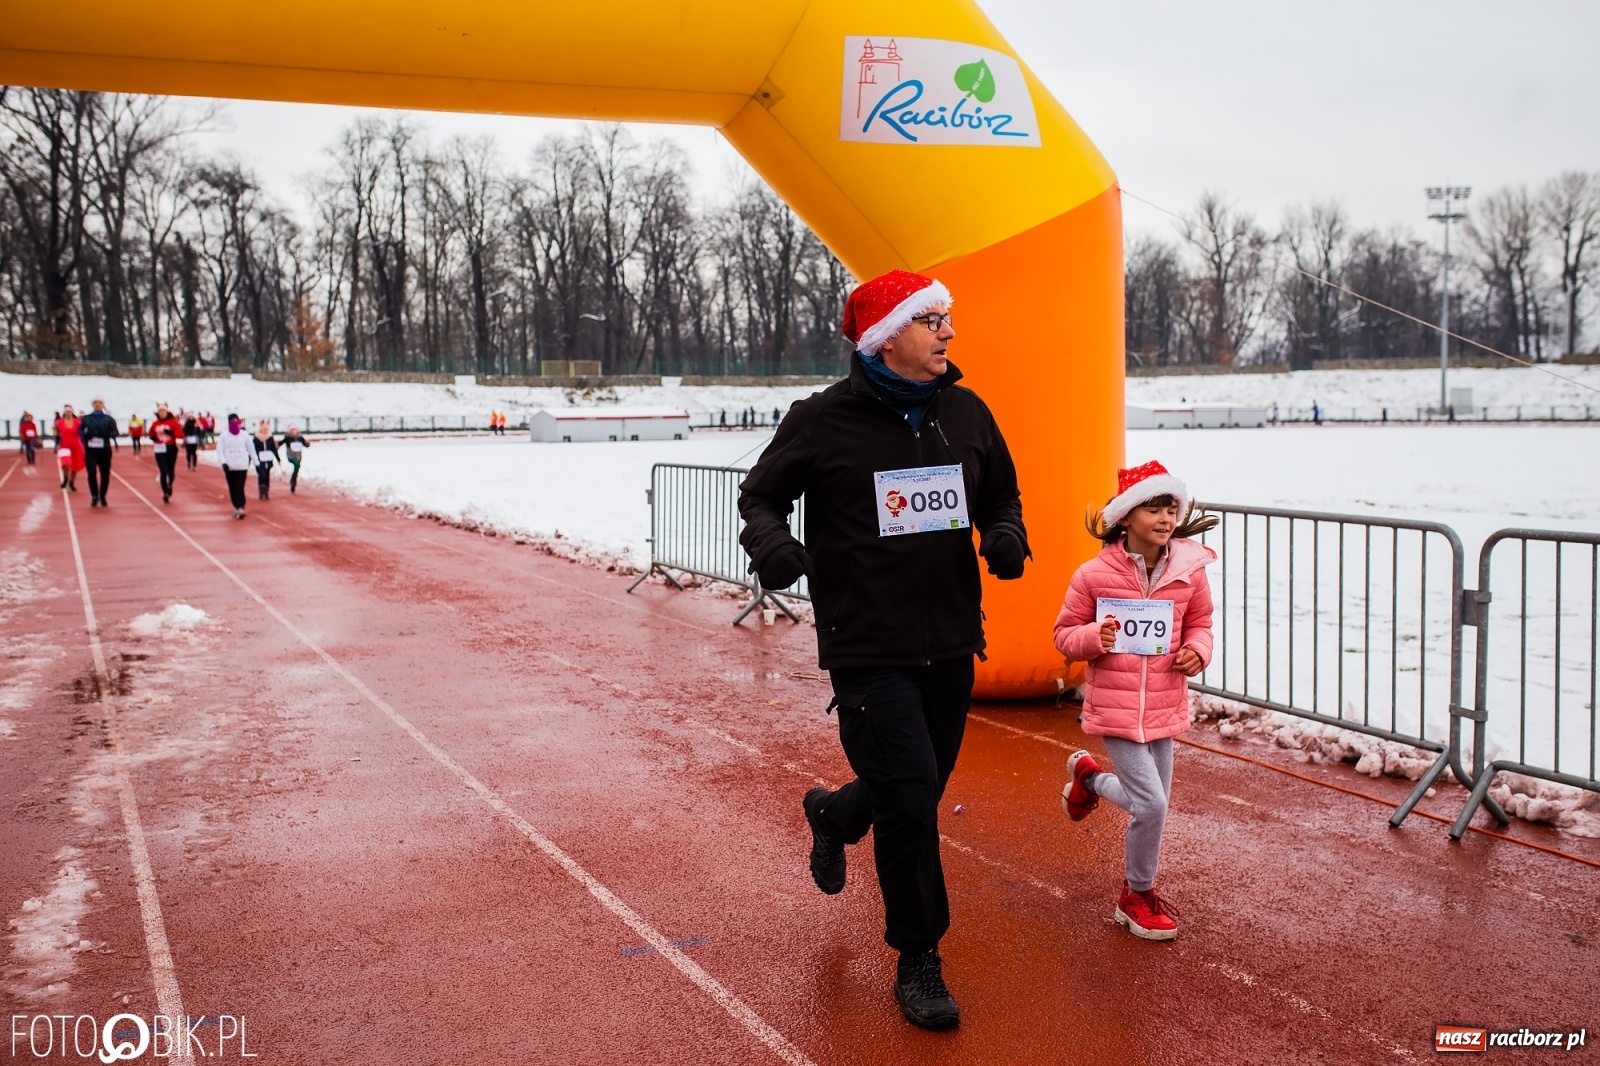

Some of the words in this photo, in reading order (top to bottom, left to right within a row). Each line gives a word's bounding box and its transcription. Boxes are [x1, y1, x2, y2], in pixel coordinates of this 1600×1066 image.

[862, 79, 1029, 142] Racibórz
[910, 489, 959, 513] 080
[1123, 619, 1167, 638] 079
